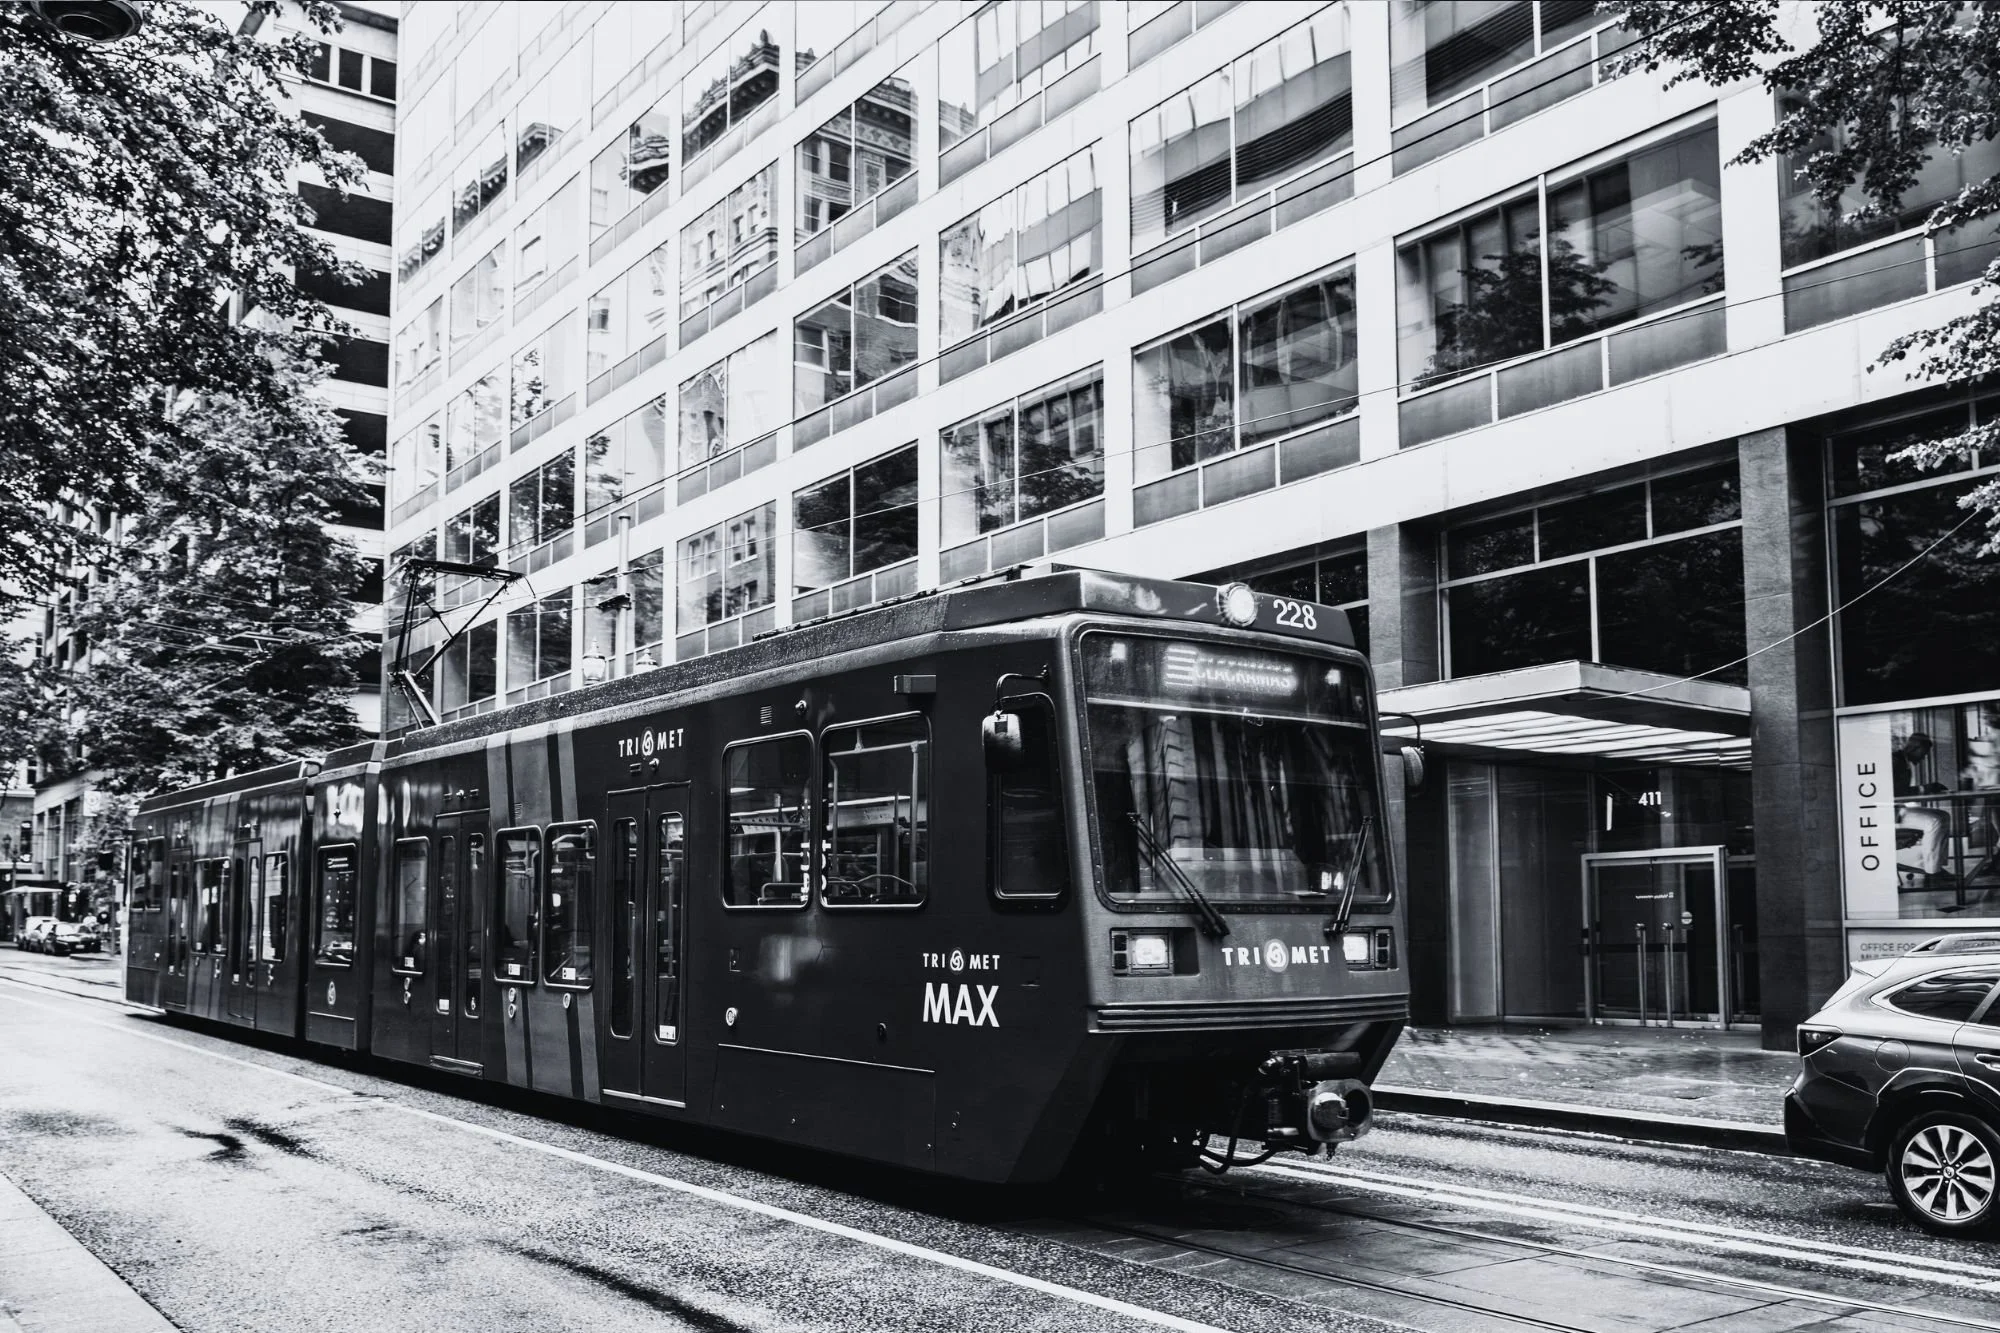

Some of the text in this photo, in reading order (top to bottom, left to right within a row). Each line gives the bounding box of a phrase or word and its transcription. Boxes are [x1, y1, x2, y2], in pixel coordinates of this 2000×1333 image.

[1273, 599, 1317, 630] 228
[1638, 791, 1661, 806] 411
[1857, 762, 1880, 872] OFFICE
[1860, 943, 1895, 952] OFFICE
[922, 982, 1001, 1028] MAX
